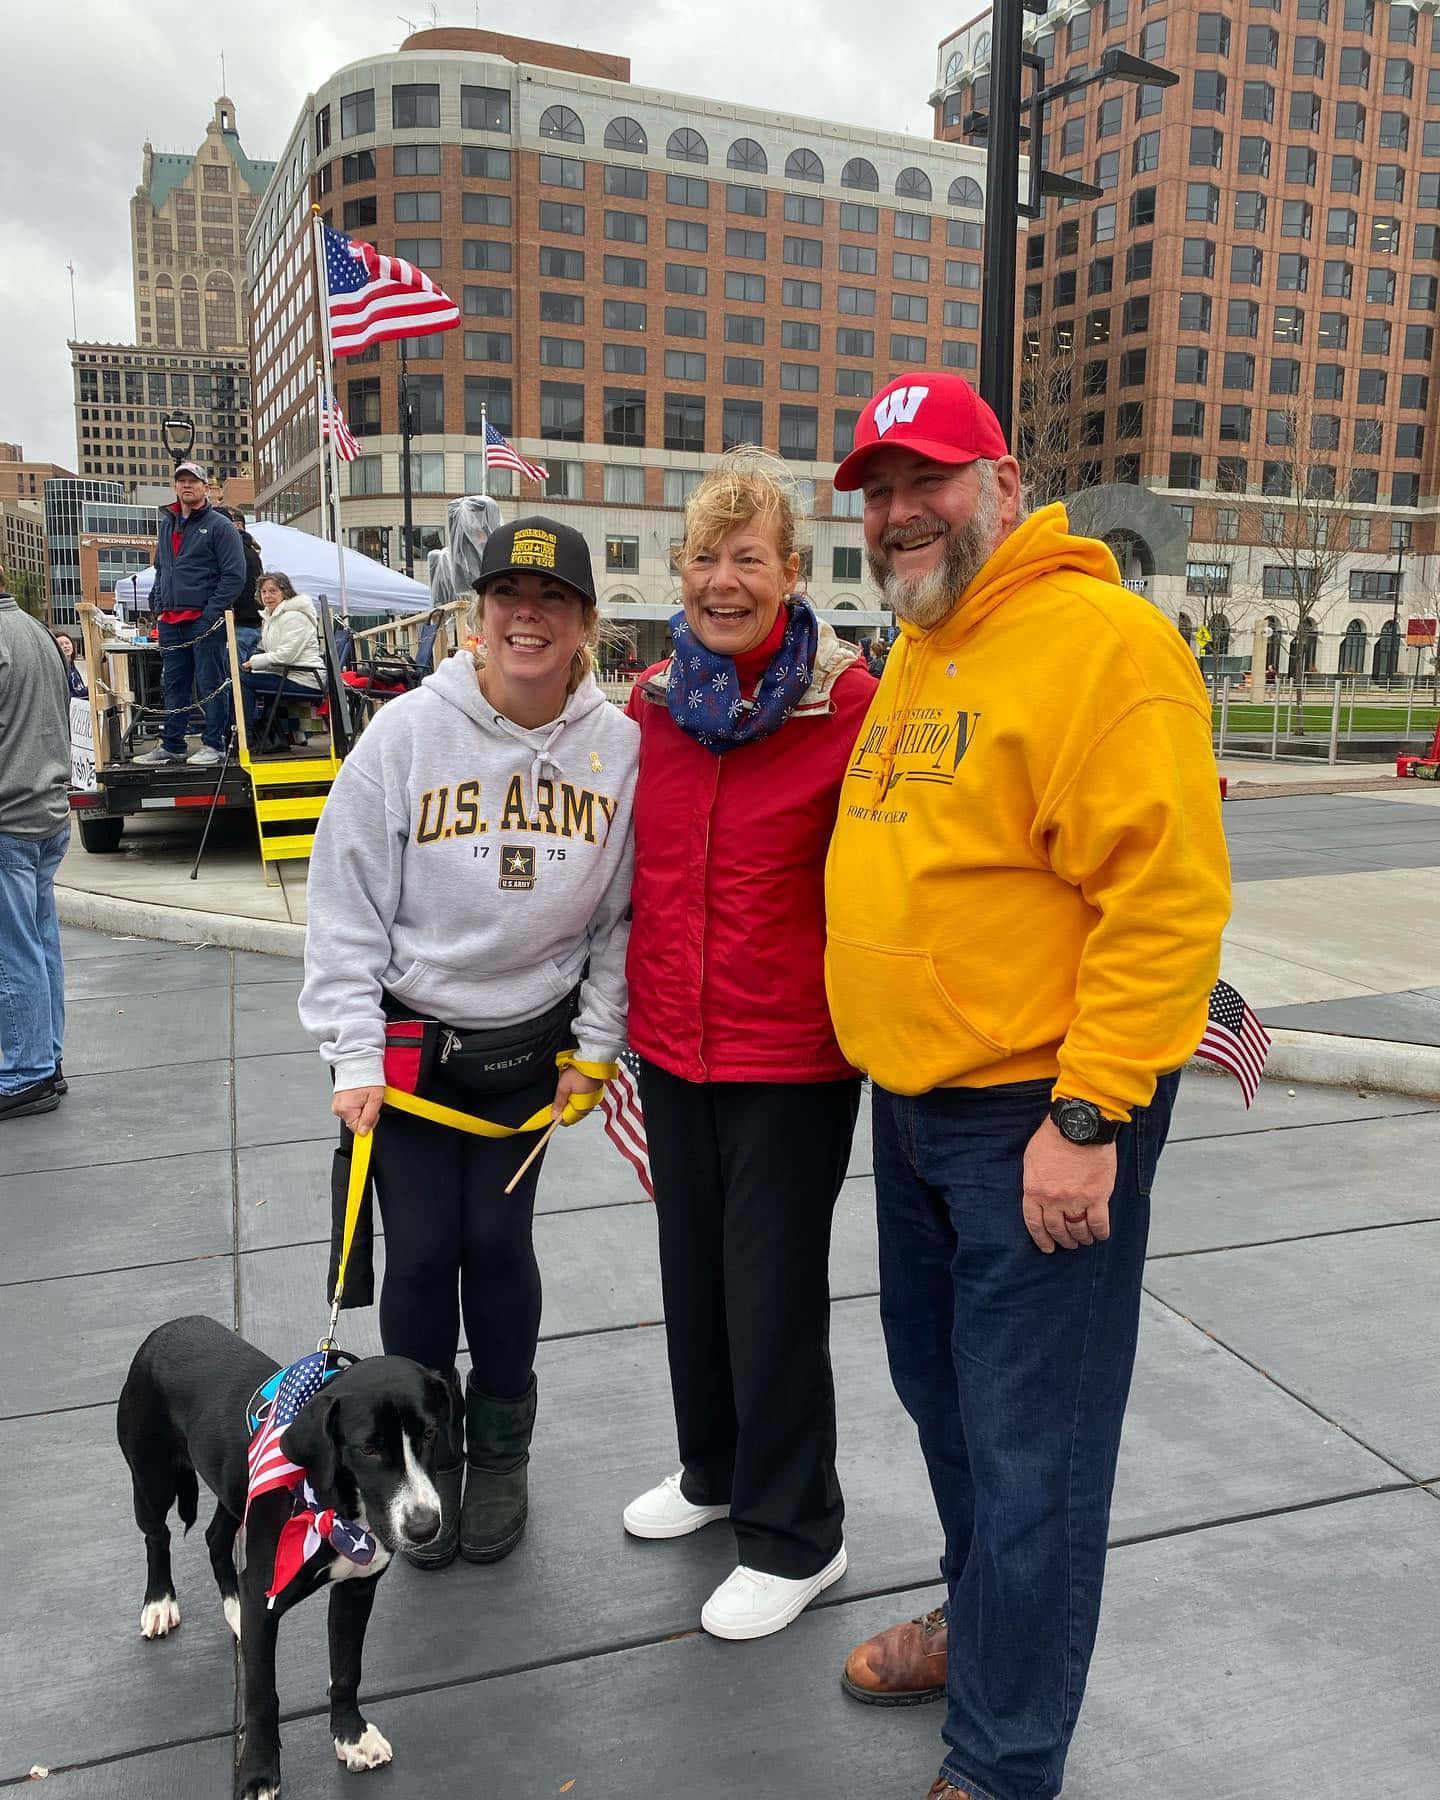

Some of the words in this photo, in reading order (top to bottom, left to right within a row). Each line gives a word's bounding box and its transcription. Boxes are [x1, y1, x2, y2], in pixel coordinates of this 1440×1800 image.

[873, 385, 929, 440] W
[416, 779, 488, 845] U.S.
[500, 771, 619, 849] ARMY
[847, 805, 871, 819] FORT
[473, 846, 490, 858] 17
[547, 849, 567, 861] 75
[484, 1052, 534, 1071] KELTY
